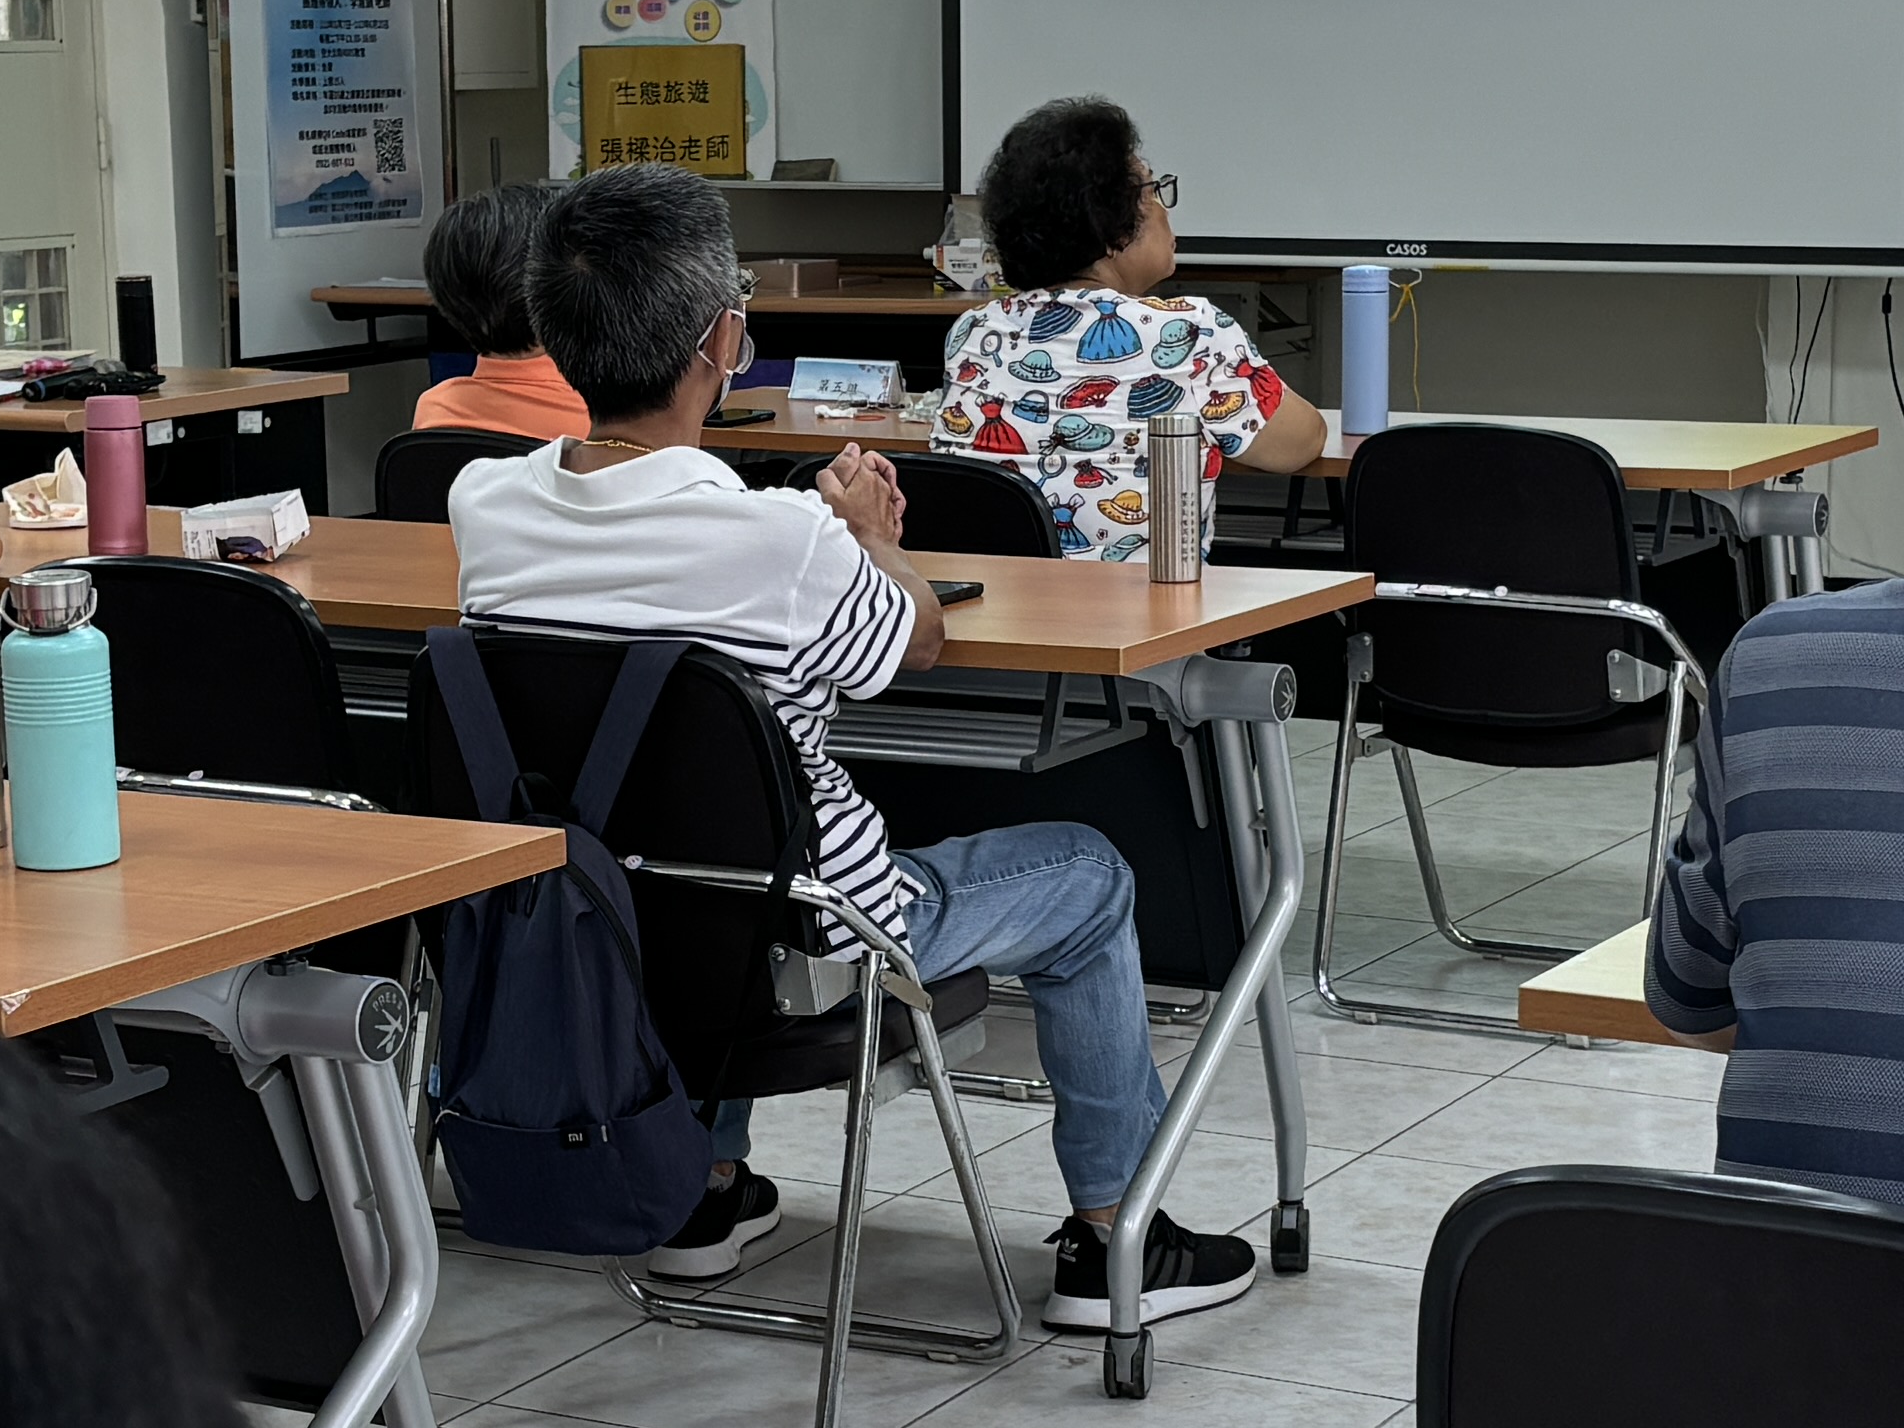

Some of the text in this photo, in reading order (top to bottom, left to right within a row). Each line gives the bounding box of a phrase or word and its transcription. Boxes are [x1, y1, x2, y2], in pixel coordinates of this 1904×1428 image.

[615, 79, 709, 106] 生態旅遊
[1386, 243, 1428, 256] CASOS
